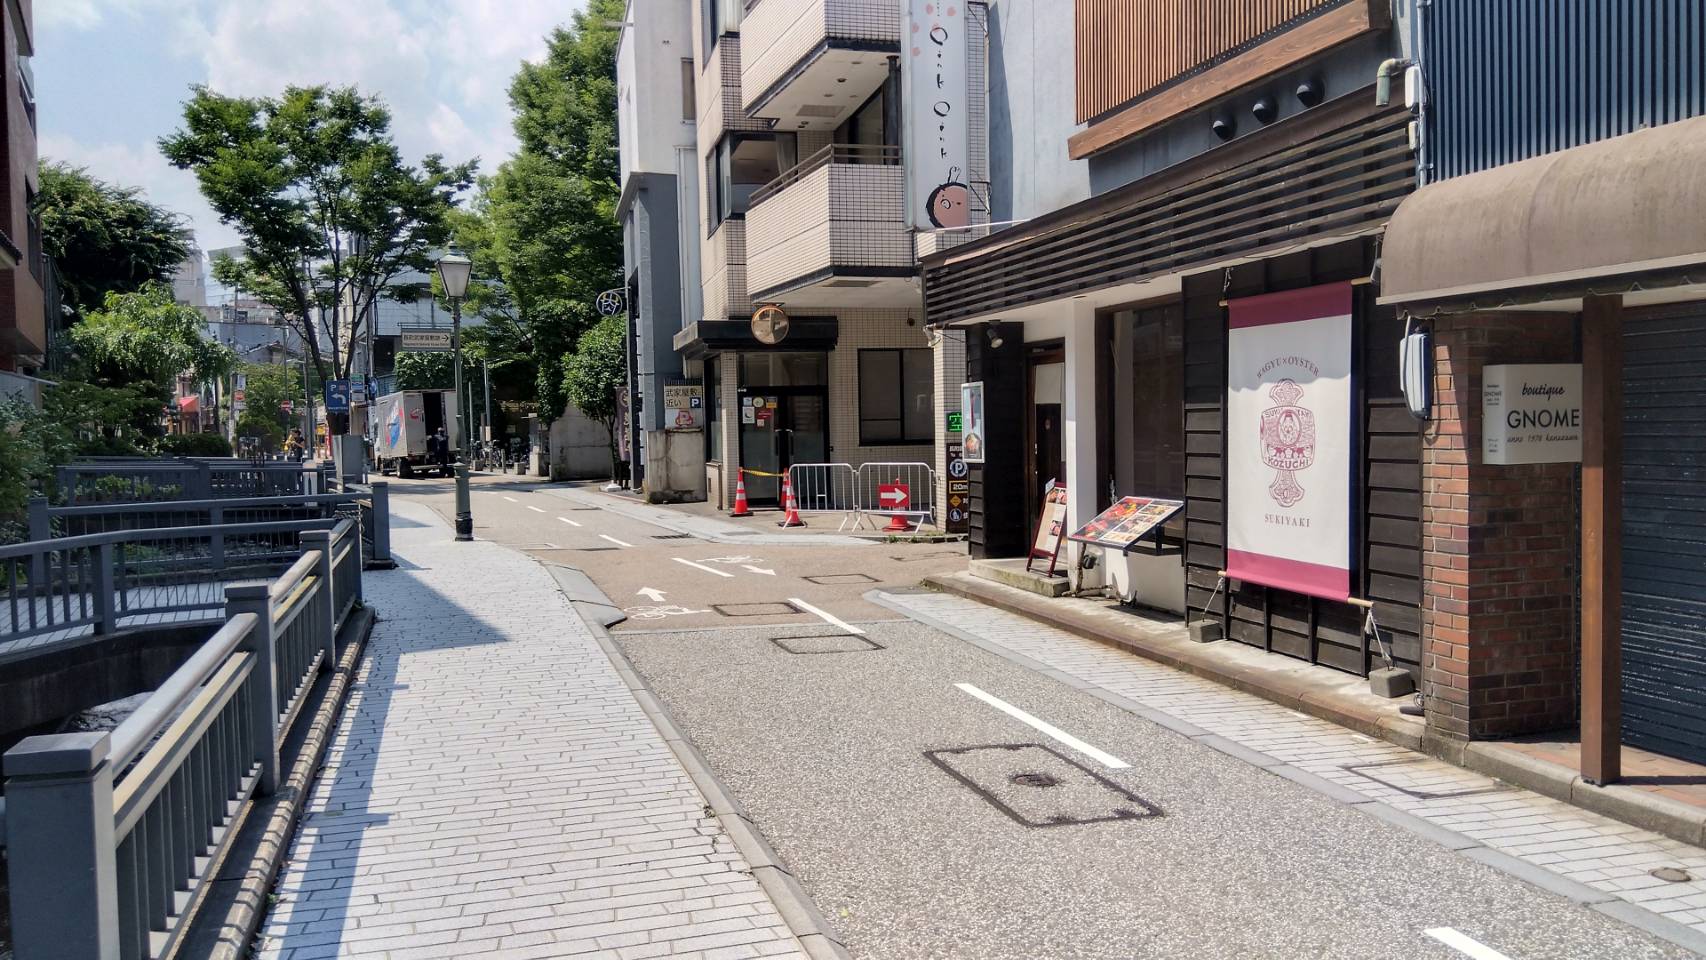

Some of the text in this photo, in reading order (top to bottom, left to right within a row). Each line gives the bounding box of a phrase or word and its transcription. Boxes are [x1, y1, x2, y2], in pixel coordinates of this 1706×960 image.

[1522, 383, 1565, 400] boutique
[666, 398, 700, 407] 近い P
[1507, 409, 1580, 429] GNOME
[1267, 457, 1310, 469] KOZUCHI
[1264, 513, 1311, 528] SUKIYAKI
